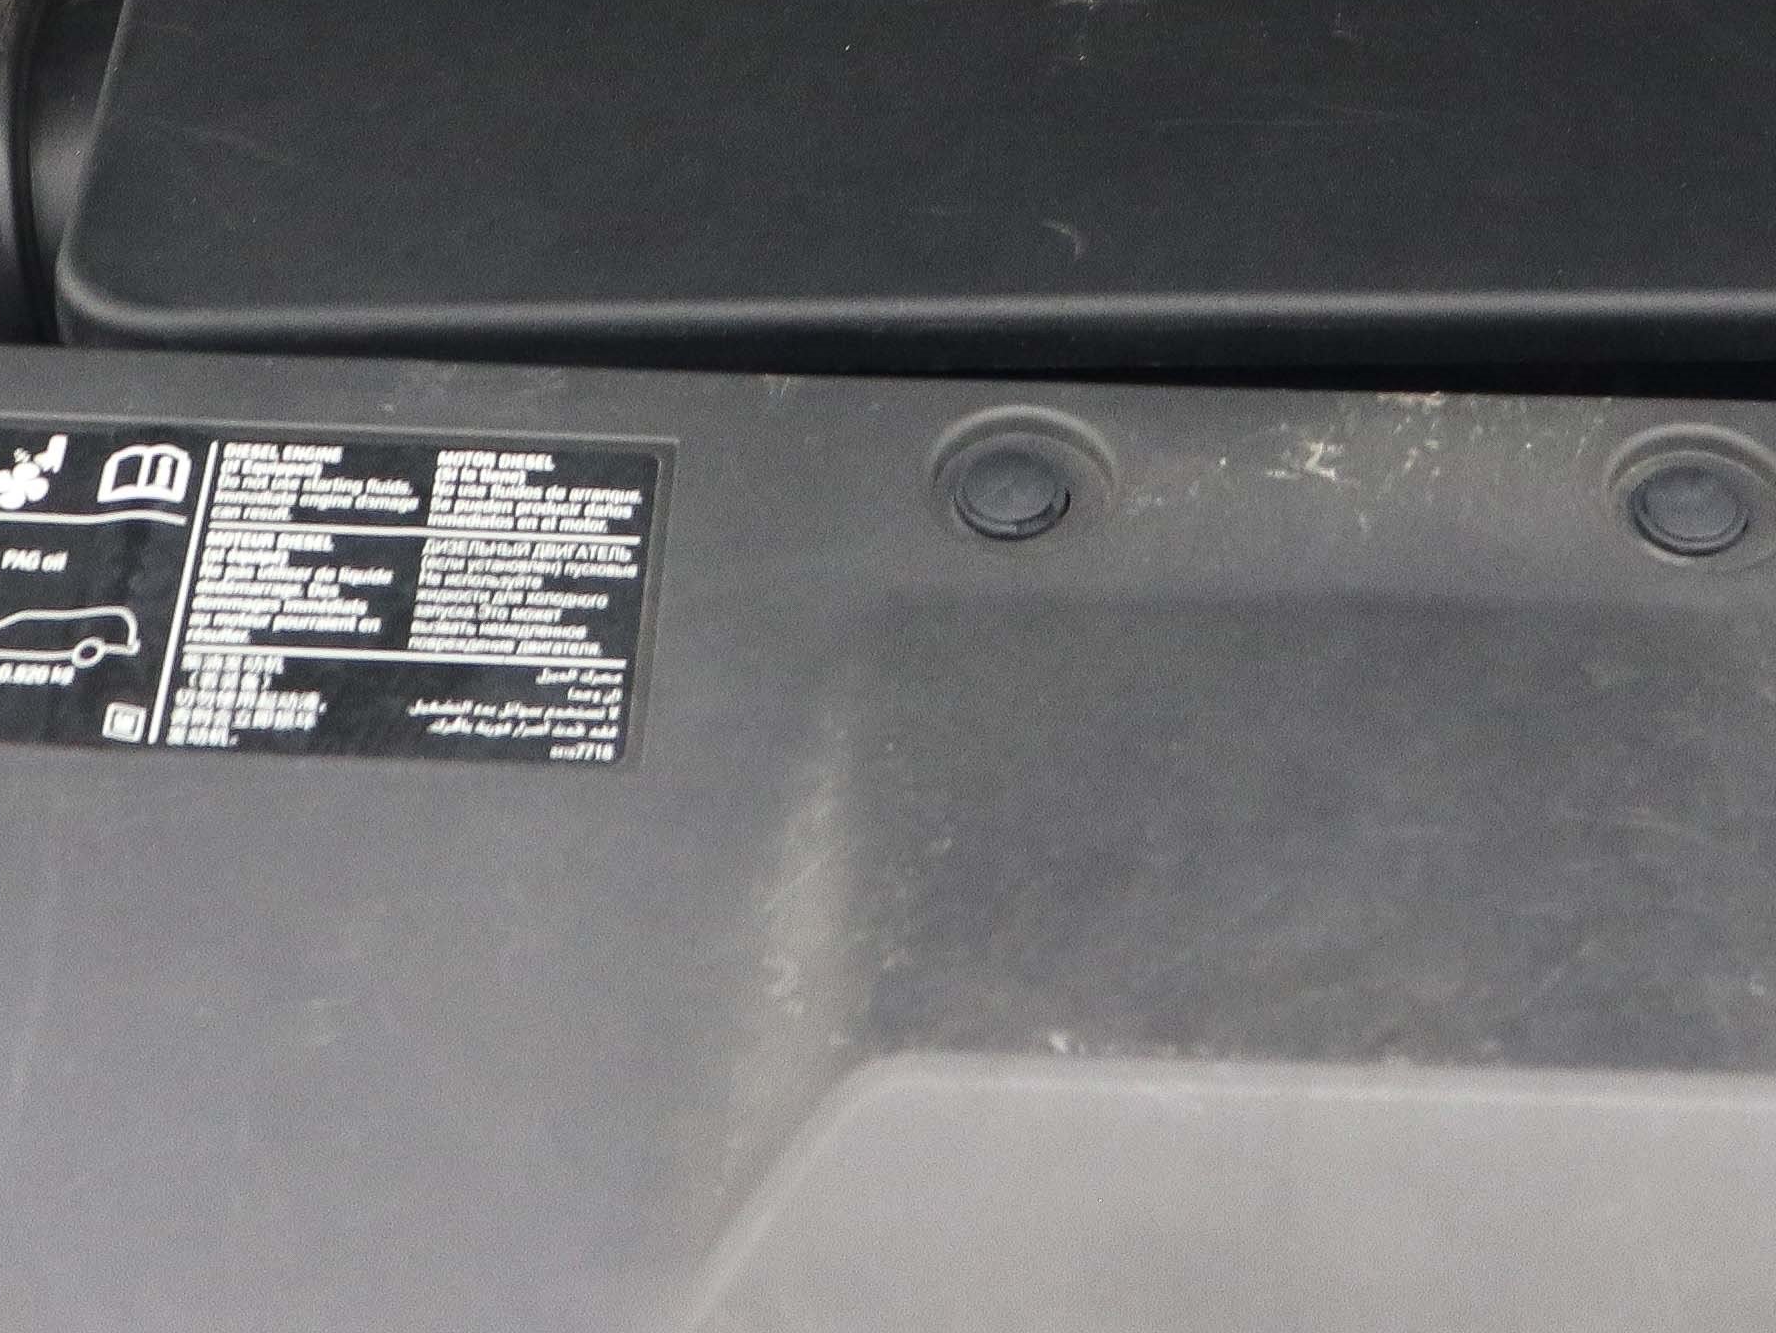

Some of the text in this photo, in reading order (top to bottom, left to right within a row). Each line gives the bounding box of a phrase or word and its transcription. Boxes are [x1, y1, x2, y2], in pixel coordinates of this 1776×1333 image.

[224, 442, 344, 464] DIESEL ENGINE
[437, 450, 555, 471] MOTOR DIESEL
[242, 475, 269, 490] not
[271, 476, 300, 491] use
[302, 476, 364, 496] starting
[457, 485, 487, 498] use
[490, 484, 543, 500] fluidos
[545, 485, 566, 500] de
[210, 506, 242, 520] can
[299, 494, 353, 511] engine
[355, 494, 420, 514] damage
[453, 499, 514, 515] pueden
[515, 501, 583, 517] producir
[205, 531, 335, 552] MOTEUR DIESEL
[422, 538, 632, 563] ДИЗЕЛЬНЫЙ ДВИГАТЕЛЬ
